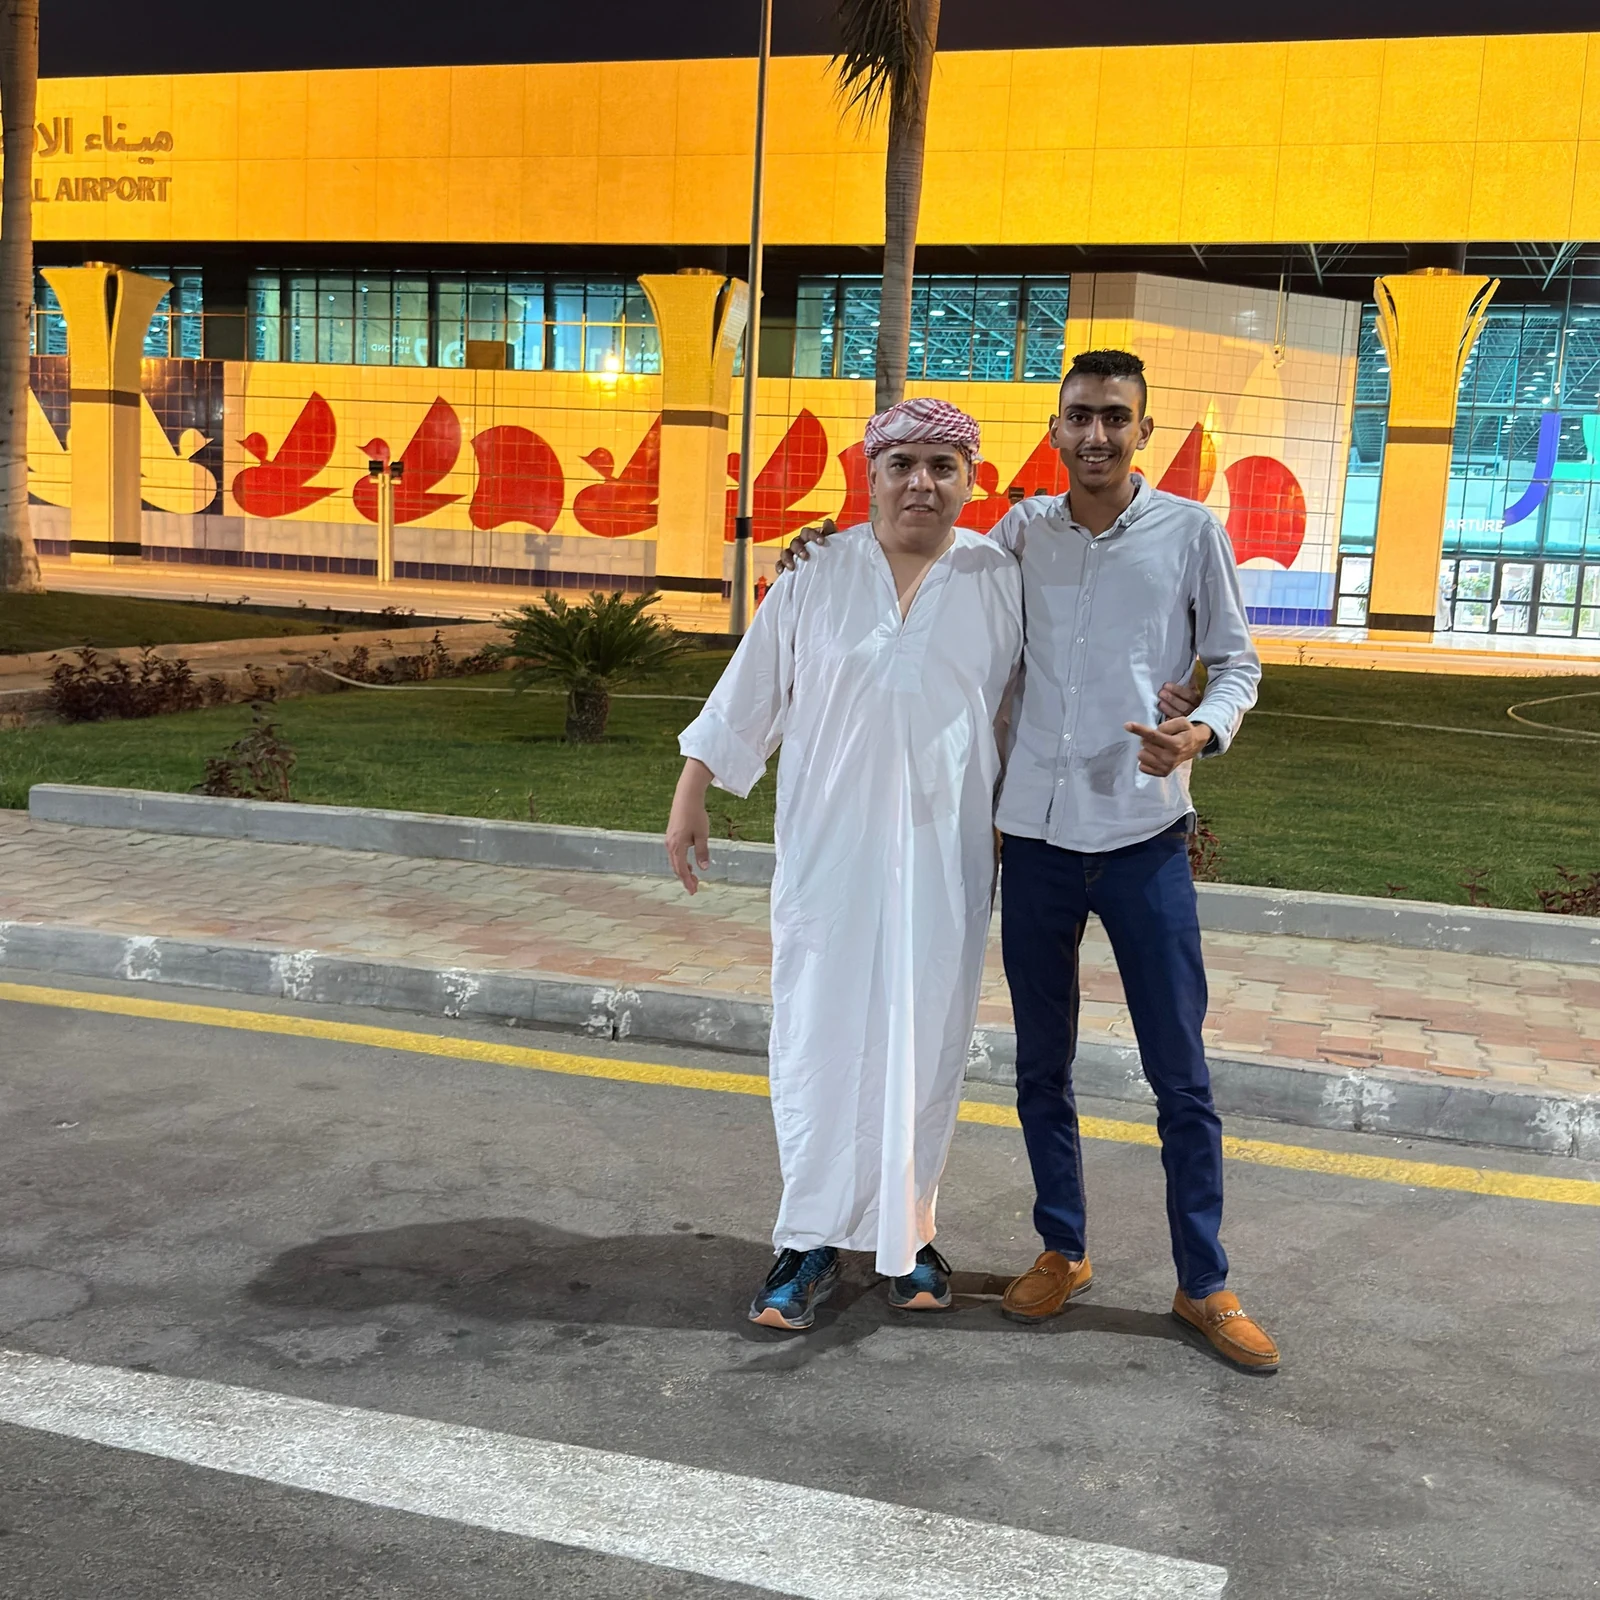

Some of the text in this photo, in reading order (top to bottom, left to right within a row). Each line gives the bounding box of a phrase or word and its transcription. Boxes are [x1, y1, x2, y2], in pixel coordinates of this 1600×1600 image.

[32, 115, 174, 165] ميناء الا
[55, 176, 172, 202] AIRPORT
[1444, 518, 1506, 533] ARTURE
